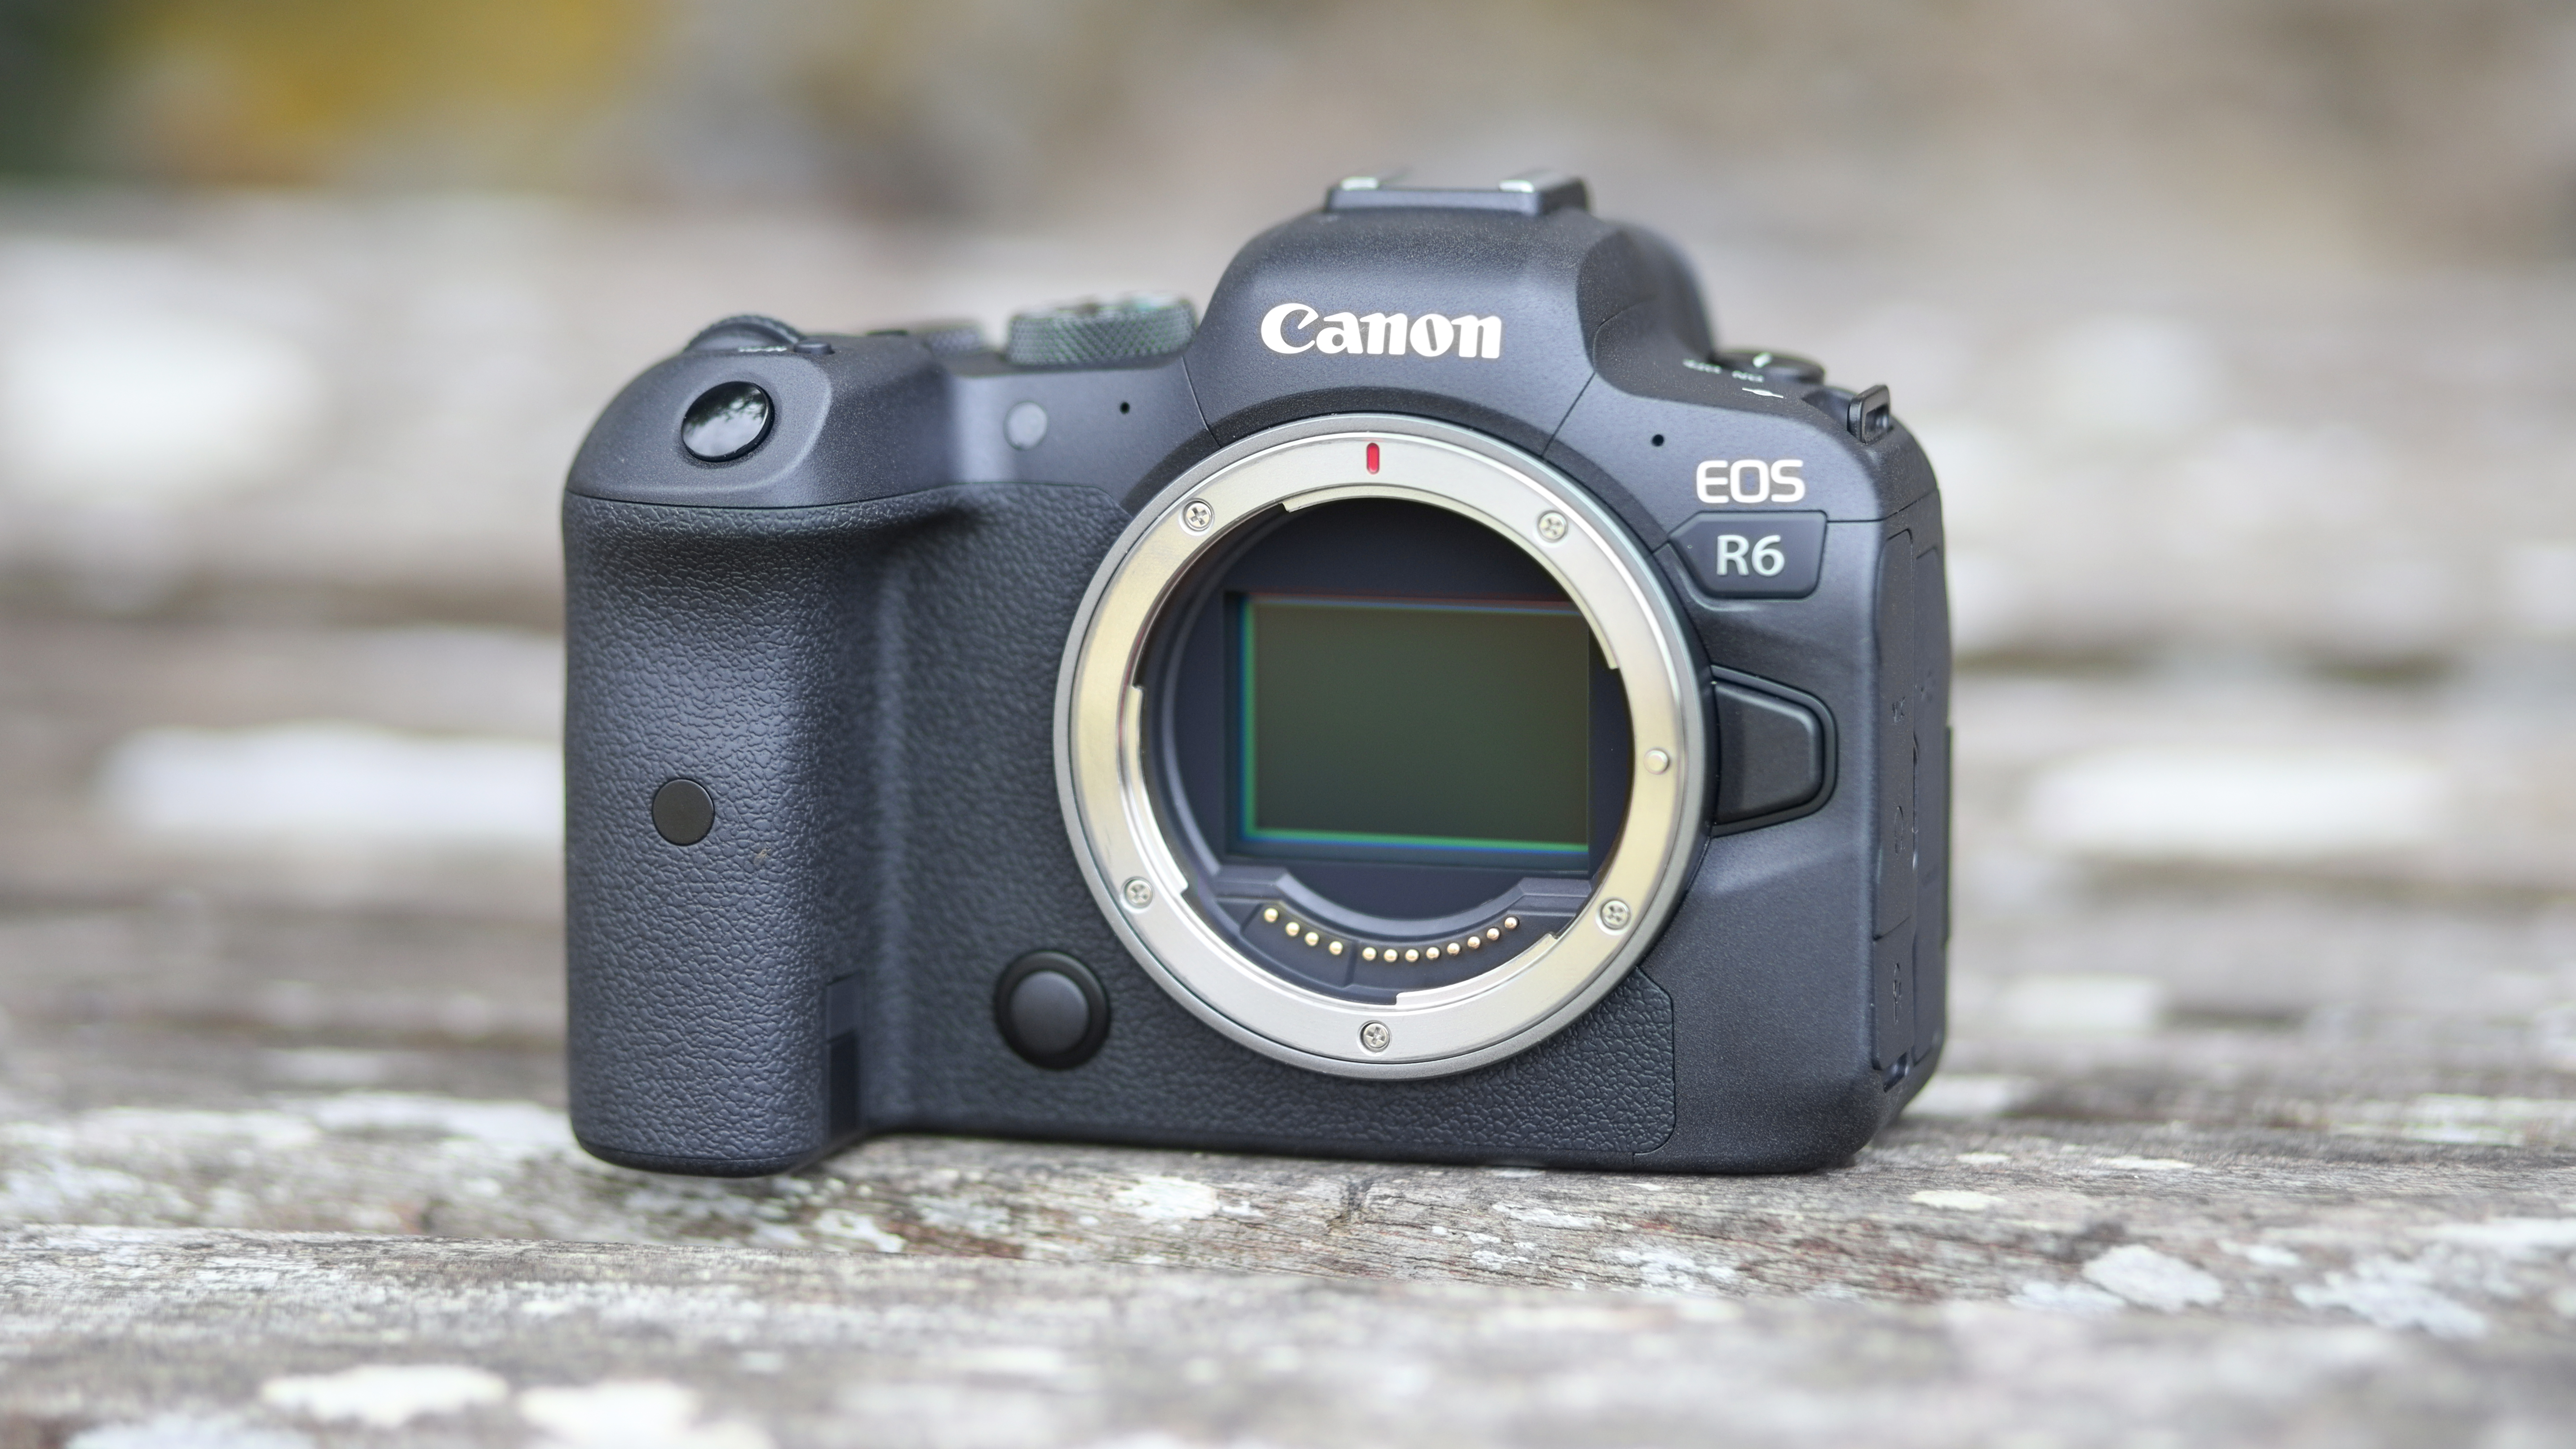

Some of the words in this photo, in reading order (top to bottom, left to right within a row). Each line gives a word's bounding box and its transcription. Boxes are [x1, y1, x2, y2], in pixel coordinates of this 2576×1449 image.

[1261, 303, 1501, 358] Canon
[1696, 459, 1806, 504] EOS
[1716, 534, 1785, 577] R6
